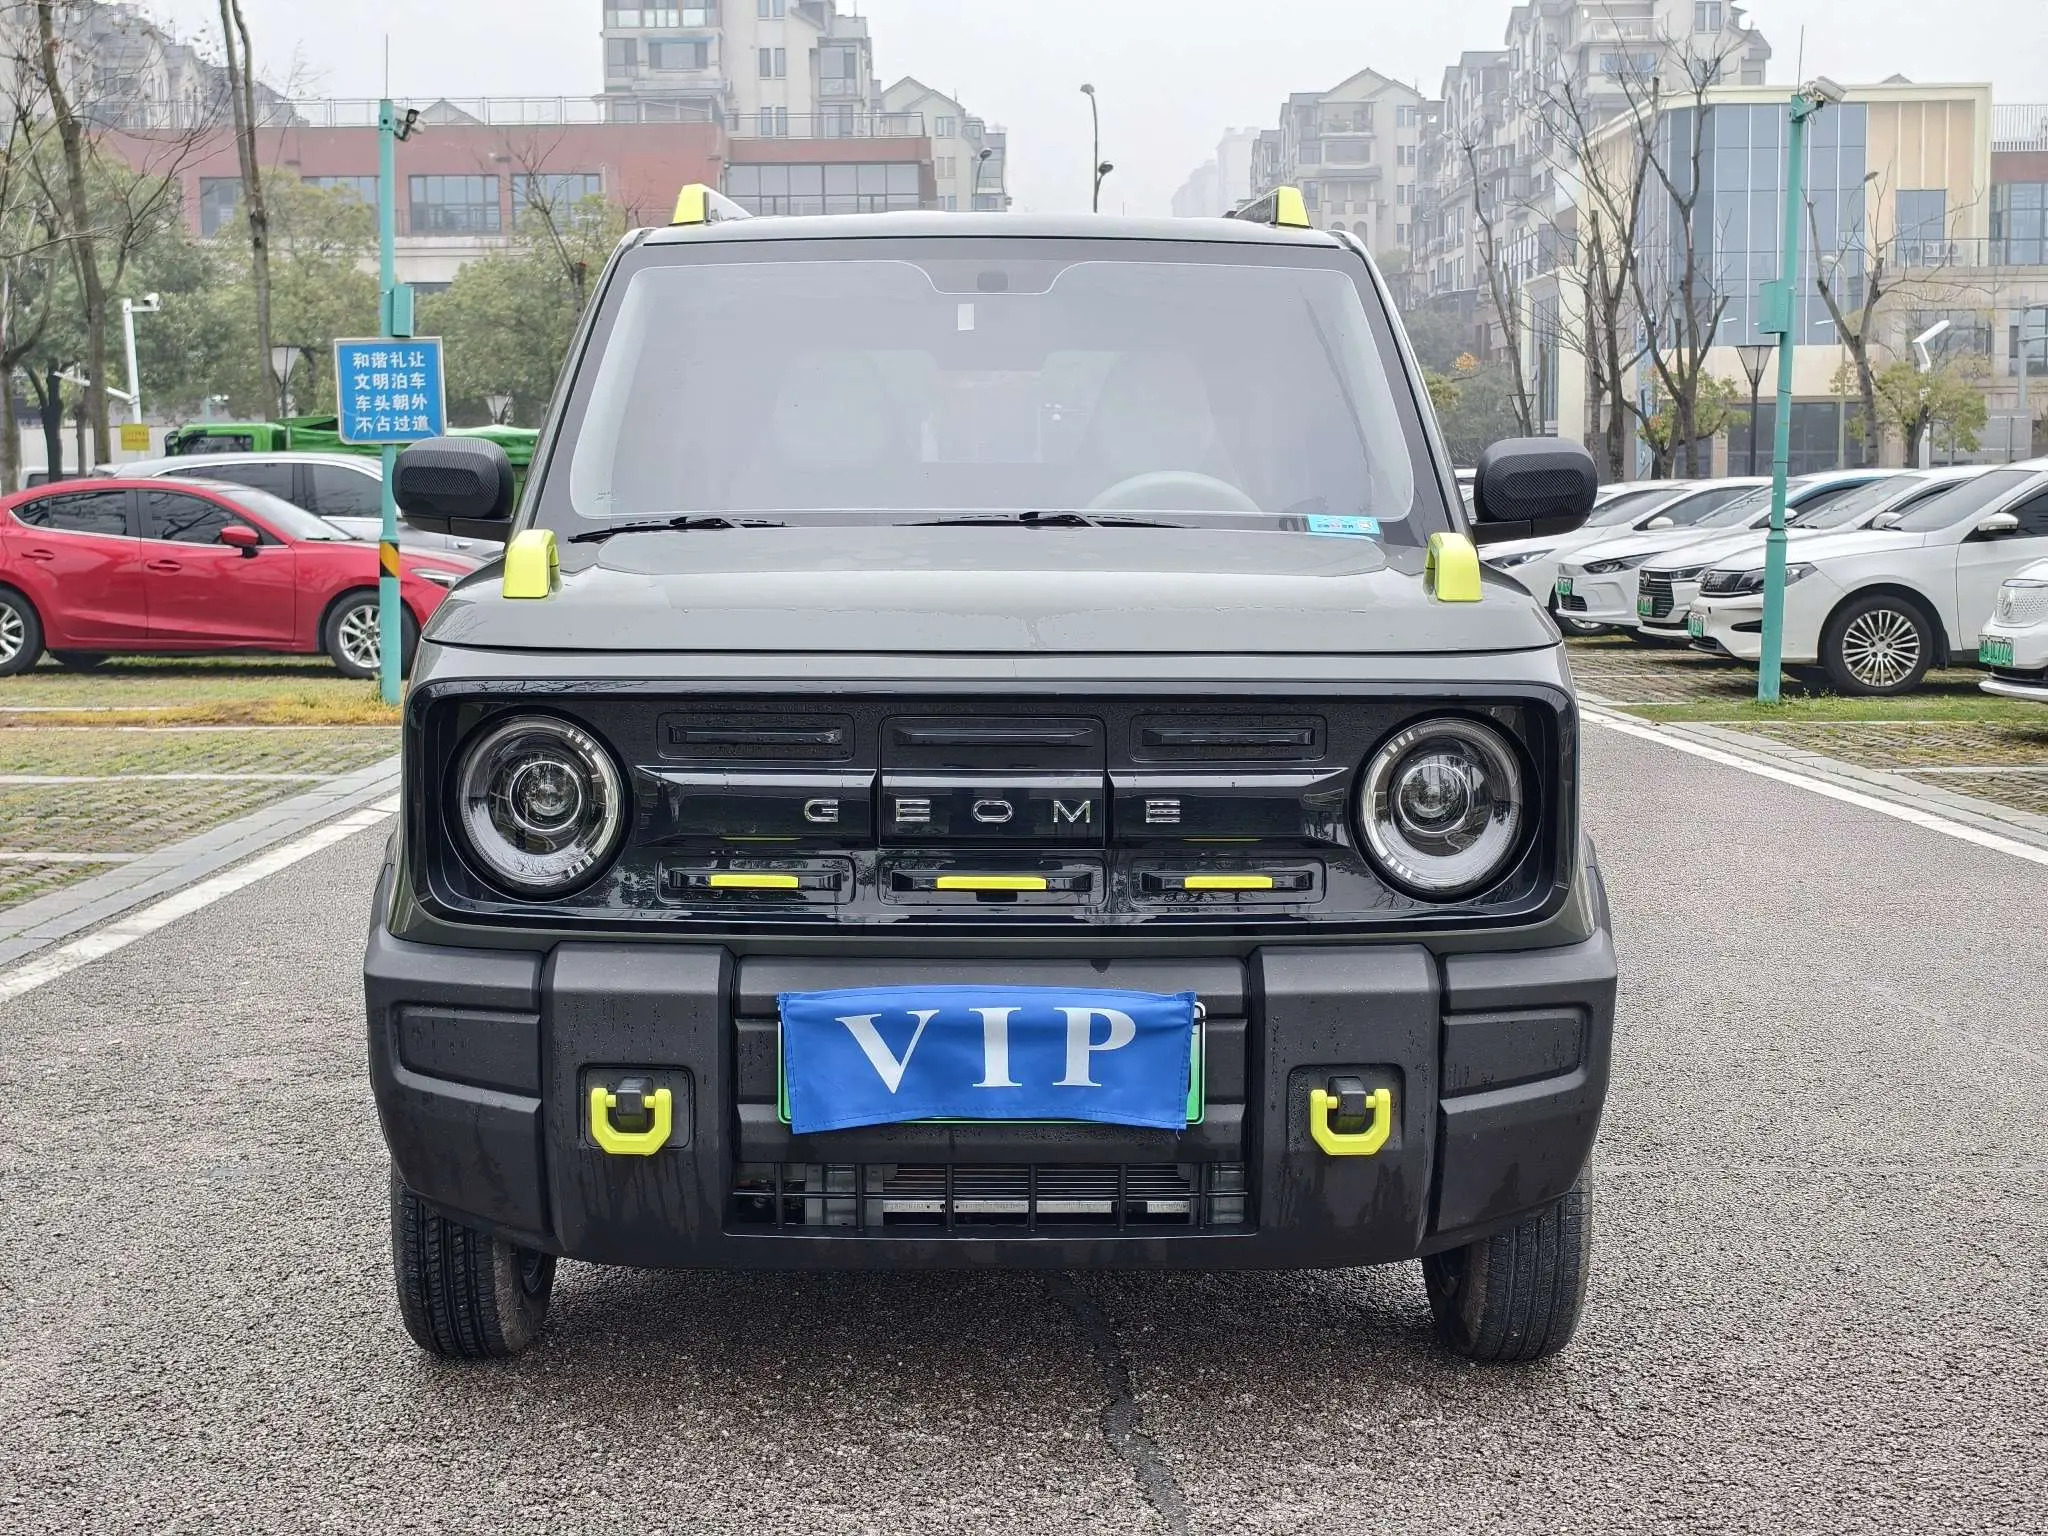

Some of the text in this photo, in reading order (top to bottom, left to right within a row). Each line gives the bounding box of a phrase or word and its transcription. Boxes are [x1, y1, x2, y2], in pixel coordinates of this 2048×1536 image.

[352, 351, 426, 369] 和谐礼让
[354, 372, 427, 390] 文明泊车
[355, 393, 428, 412] 车头朝外
[355, 415, 429, 433] 不占过道
[804, 799, 1181, 823] GEOME
[835, 1006, 1137, 1094] VIP
